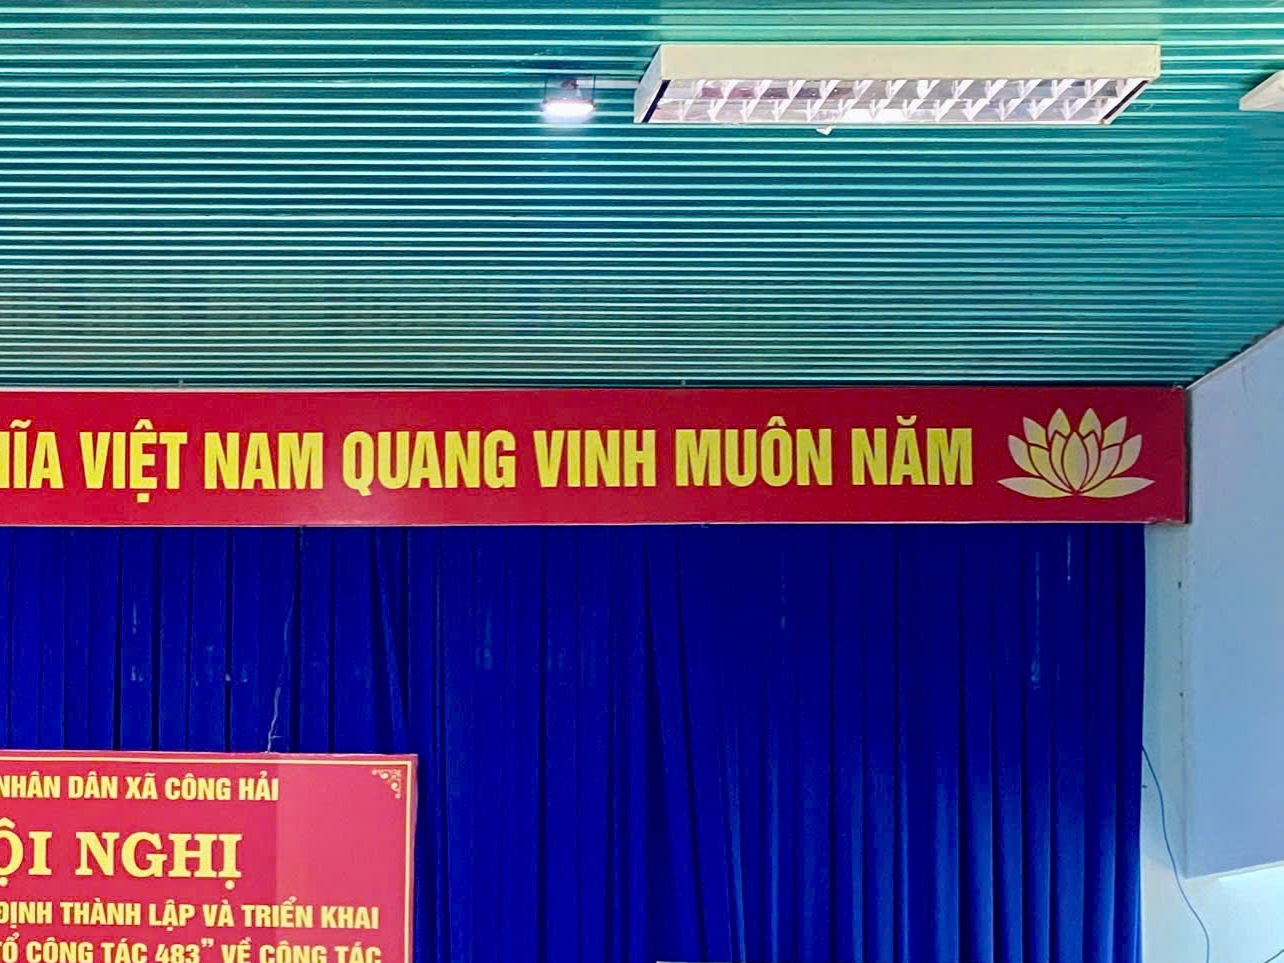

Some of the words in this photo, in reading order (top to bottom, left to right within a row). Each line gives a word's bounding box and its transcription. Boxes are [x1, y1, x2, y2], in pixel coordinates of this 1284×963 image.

[79, 419, 188, 502] VIỆT
[204, 432, 323, 489] NAM
[342, 430, 516, 497] QUANG
[533, 430, 656, 488] VINH
[675, 416, 832, 487] MUÔN
[851, 415, 973, 486] NĂM
[68, 771, 118, 799] DÂN
[125, 773, 159, 800] XÃ
[164, 773, 231, 801] CÔNG
[238, 770, 280, 801] HẢI
[74, 831, 243, 890] NGHỊ
[60, 898, 142, 926] THÀNH
[148, 898, 196, 932] LẬP
[202, 899, 235, 928] VÀ
[240, 896, 314, 929] TRIỂN
[320, 905, 380, 930] KHAI
